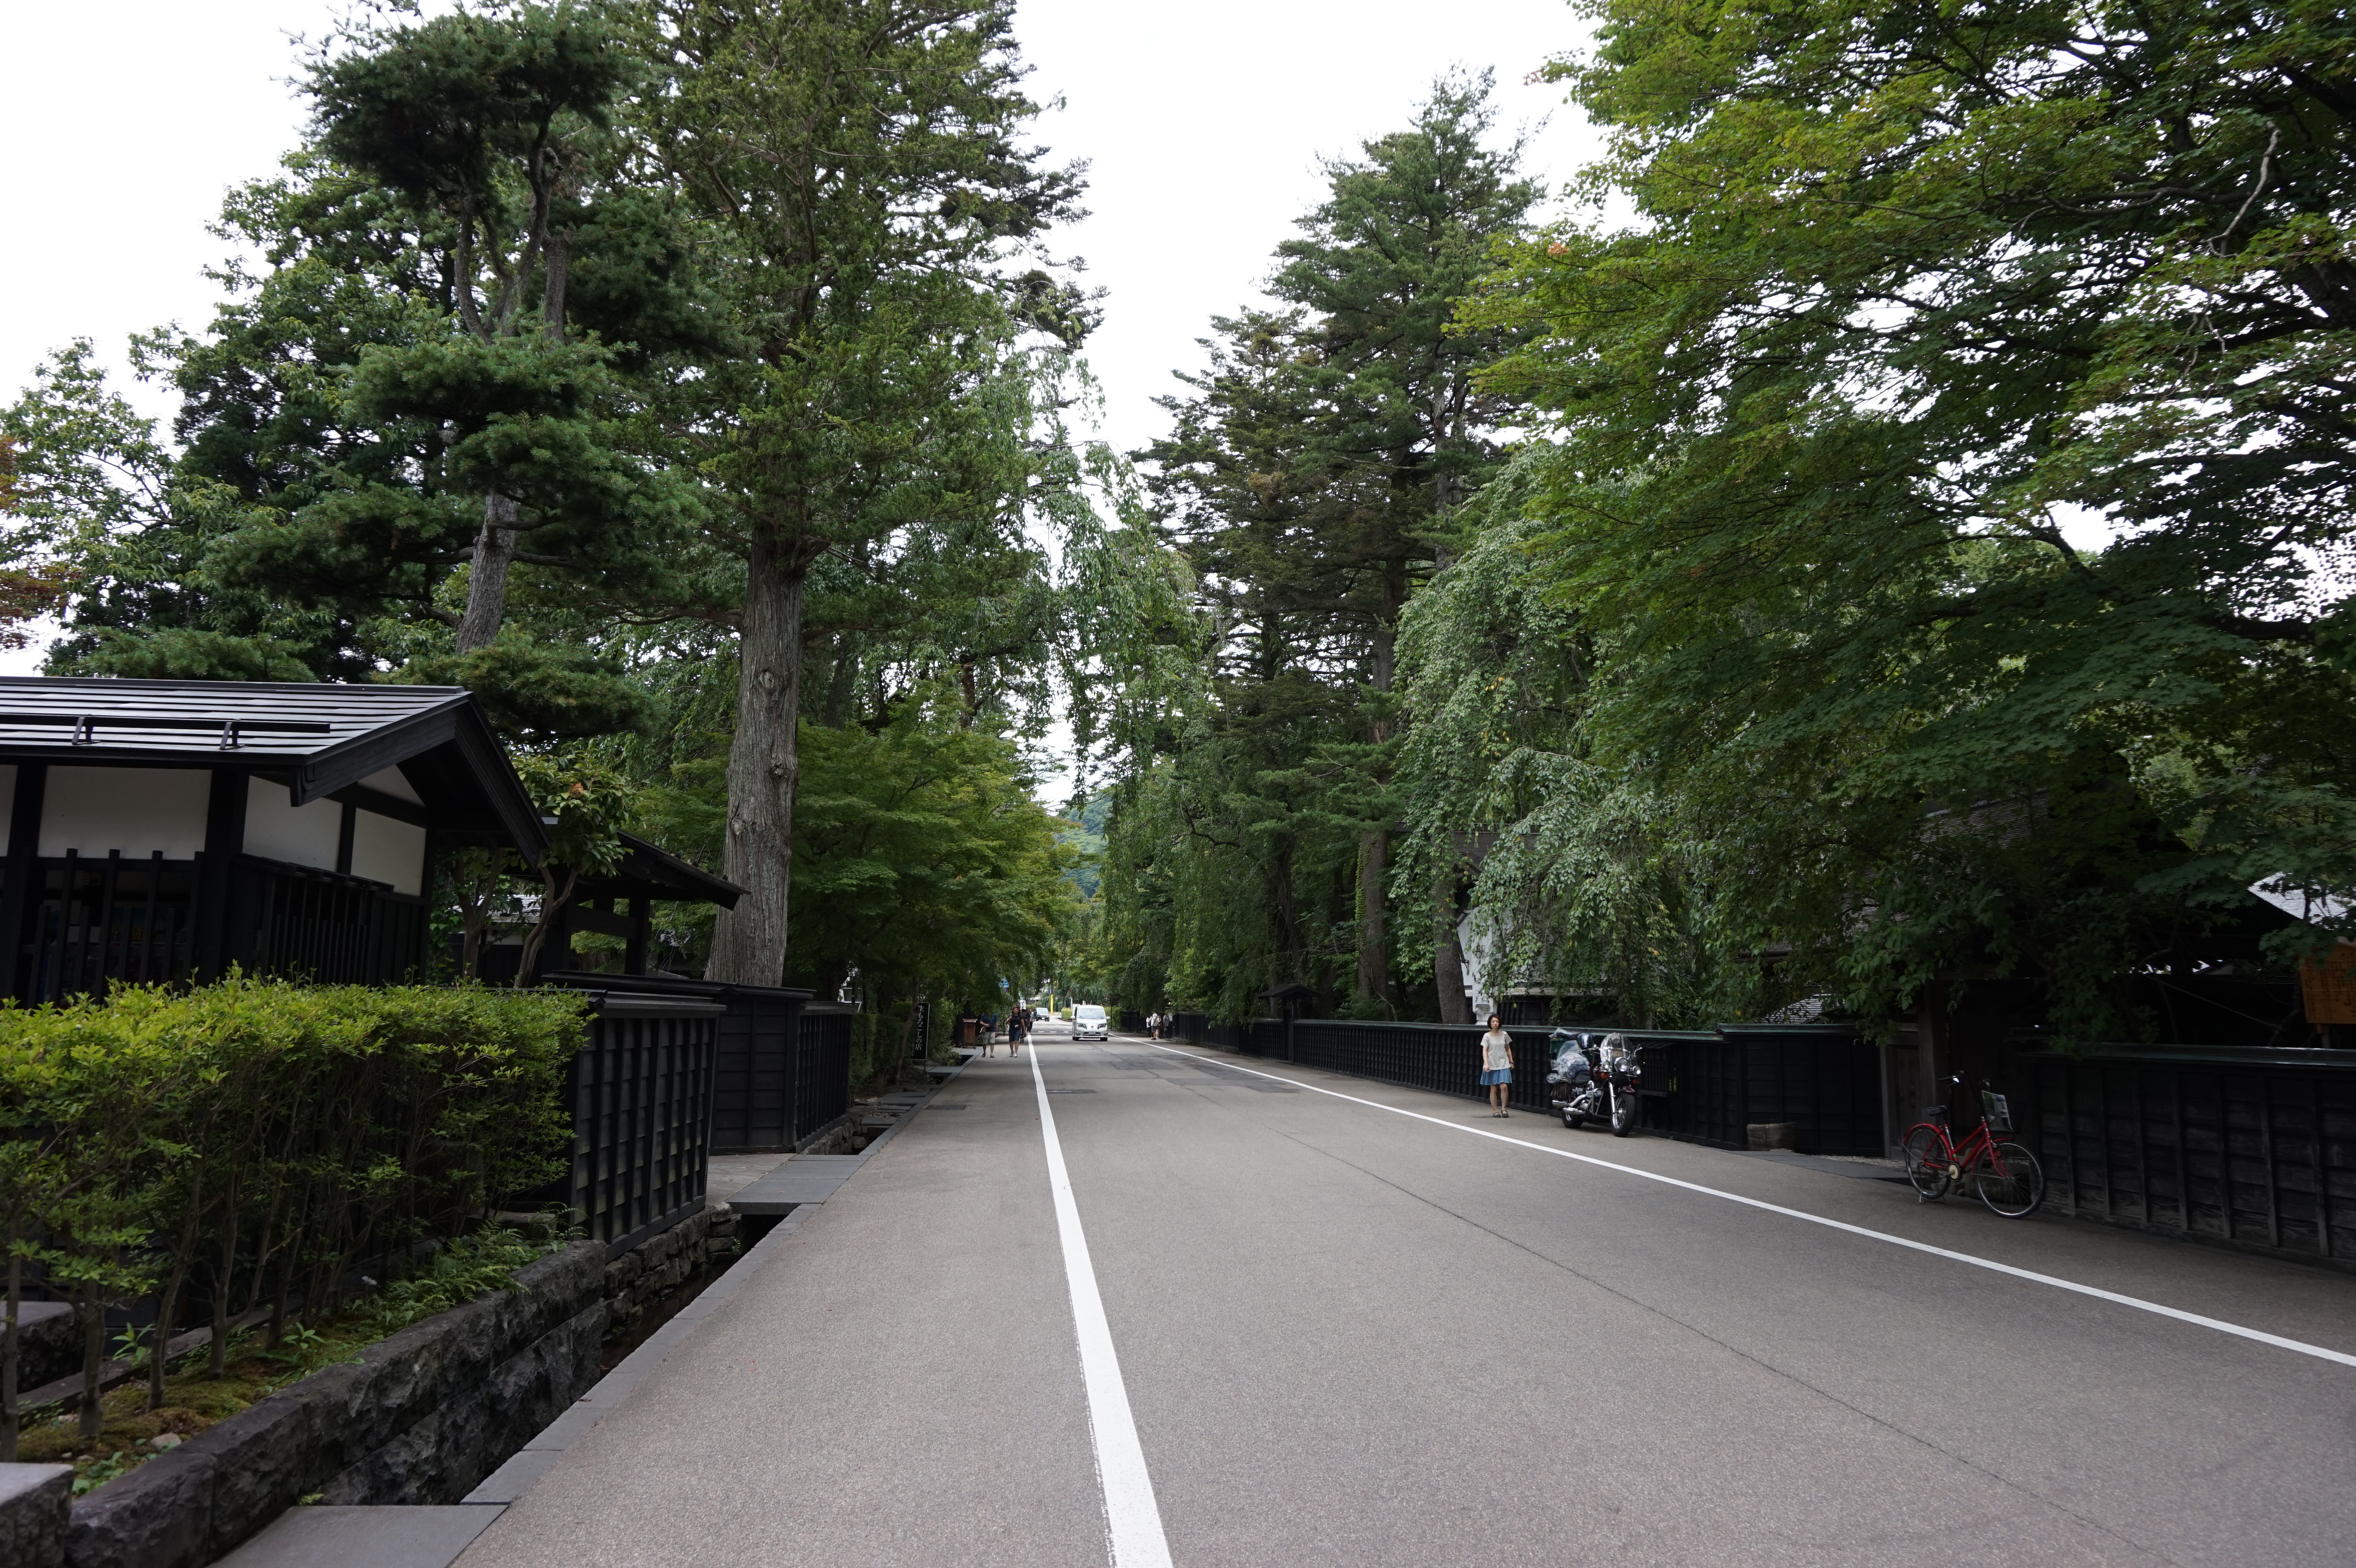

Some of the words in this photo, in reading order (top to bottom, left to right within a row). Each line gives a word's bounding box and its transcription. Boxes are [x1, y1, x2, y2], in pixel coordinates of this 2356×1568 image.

[915, 1005, 924, 1050] 生もろこしの店
